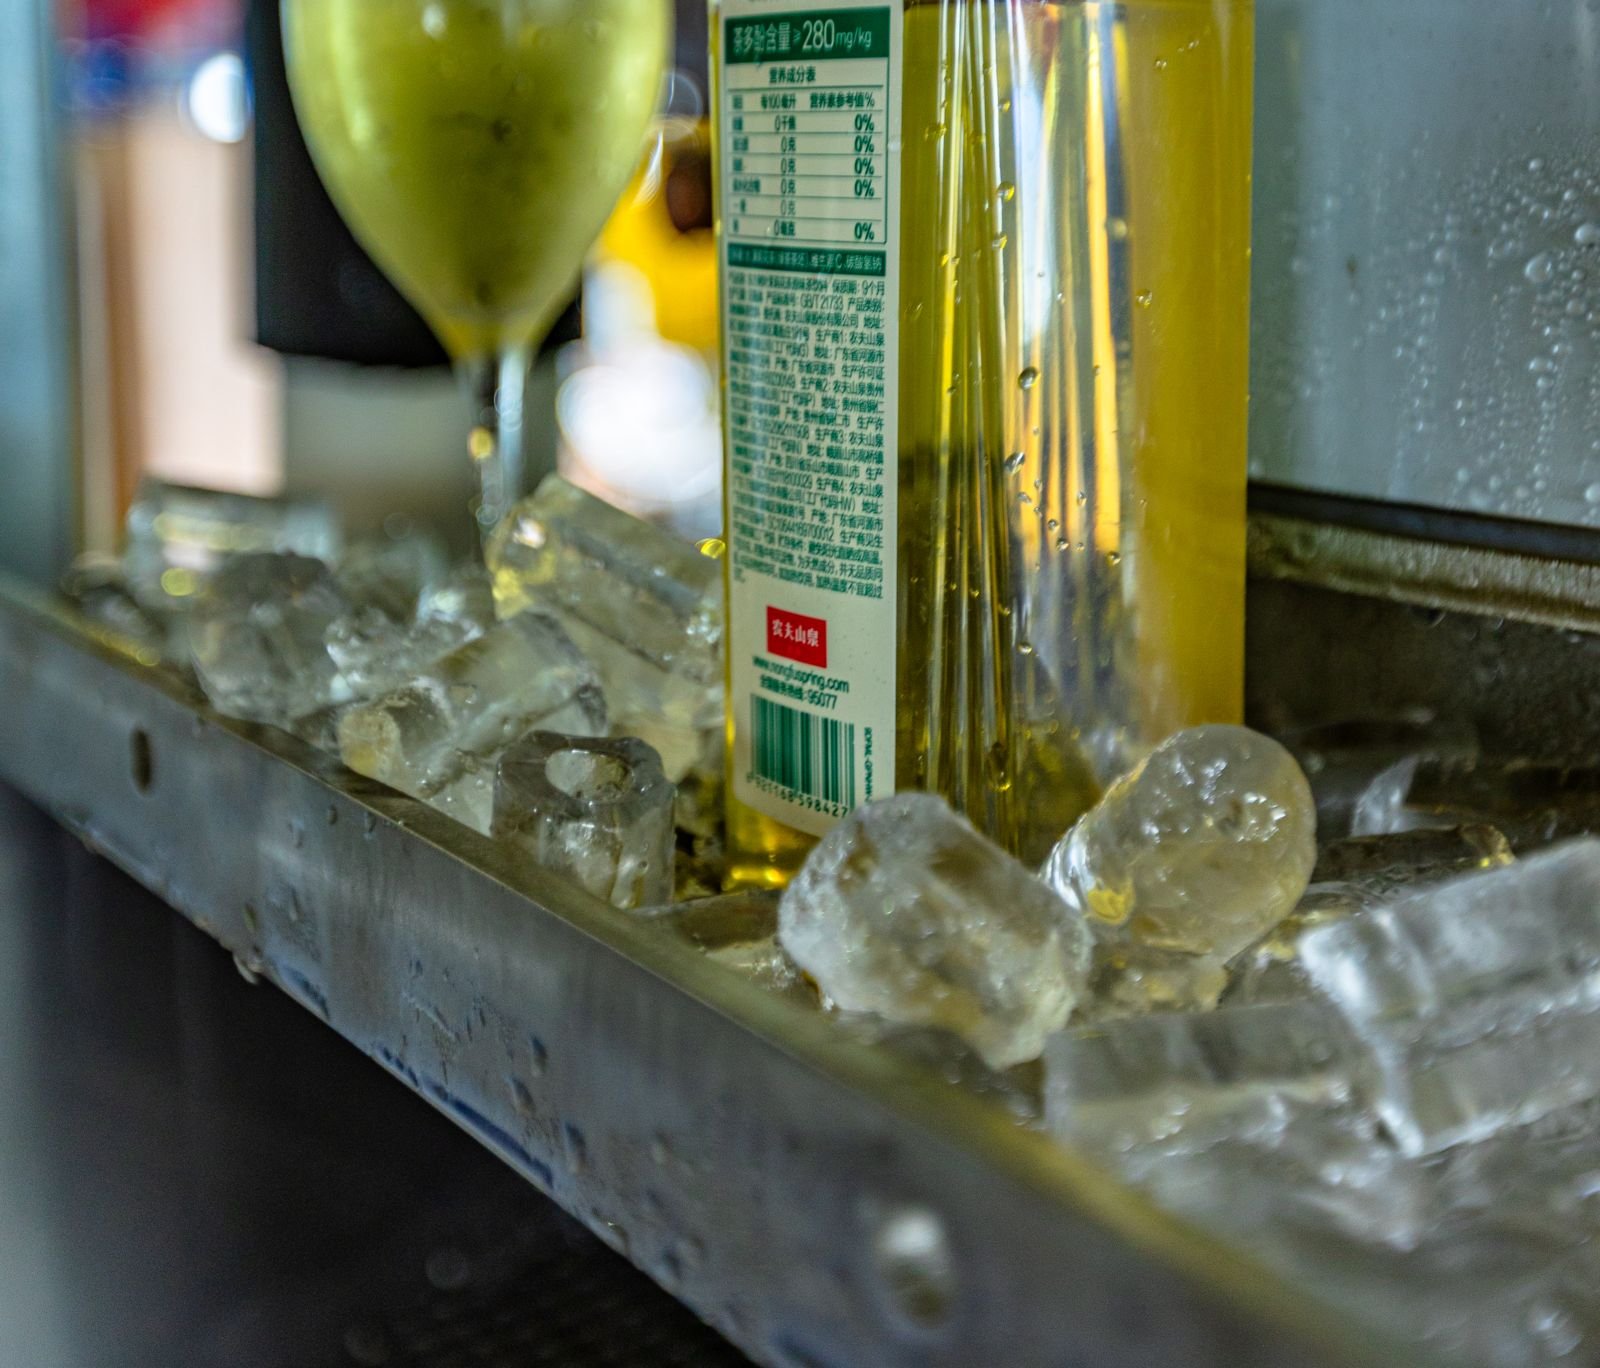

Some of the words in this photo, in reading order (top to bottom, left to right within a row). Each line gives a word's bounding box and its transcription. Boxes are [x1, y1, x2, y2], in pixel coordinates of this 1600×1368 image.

[855, 114, 874, 131] 0%
[855, 135, 874, 153] 0%
[855, 157, 874, 175] 0%
[855, 179, 874, 197] 0%
[855, 222, 874, 241] 0%
[772, 619, 819, 648] 农夫山泉
